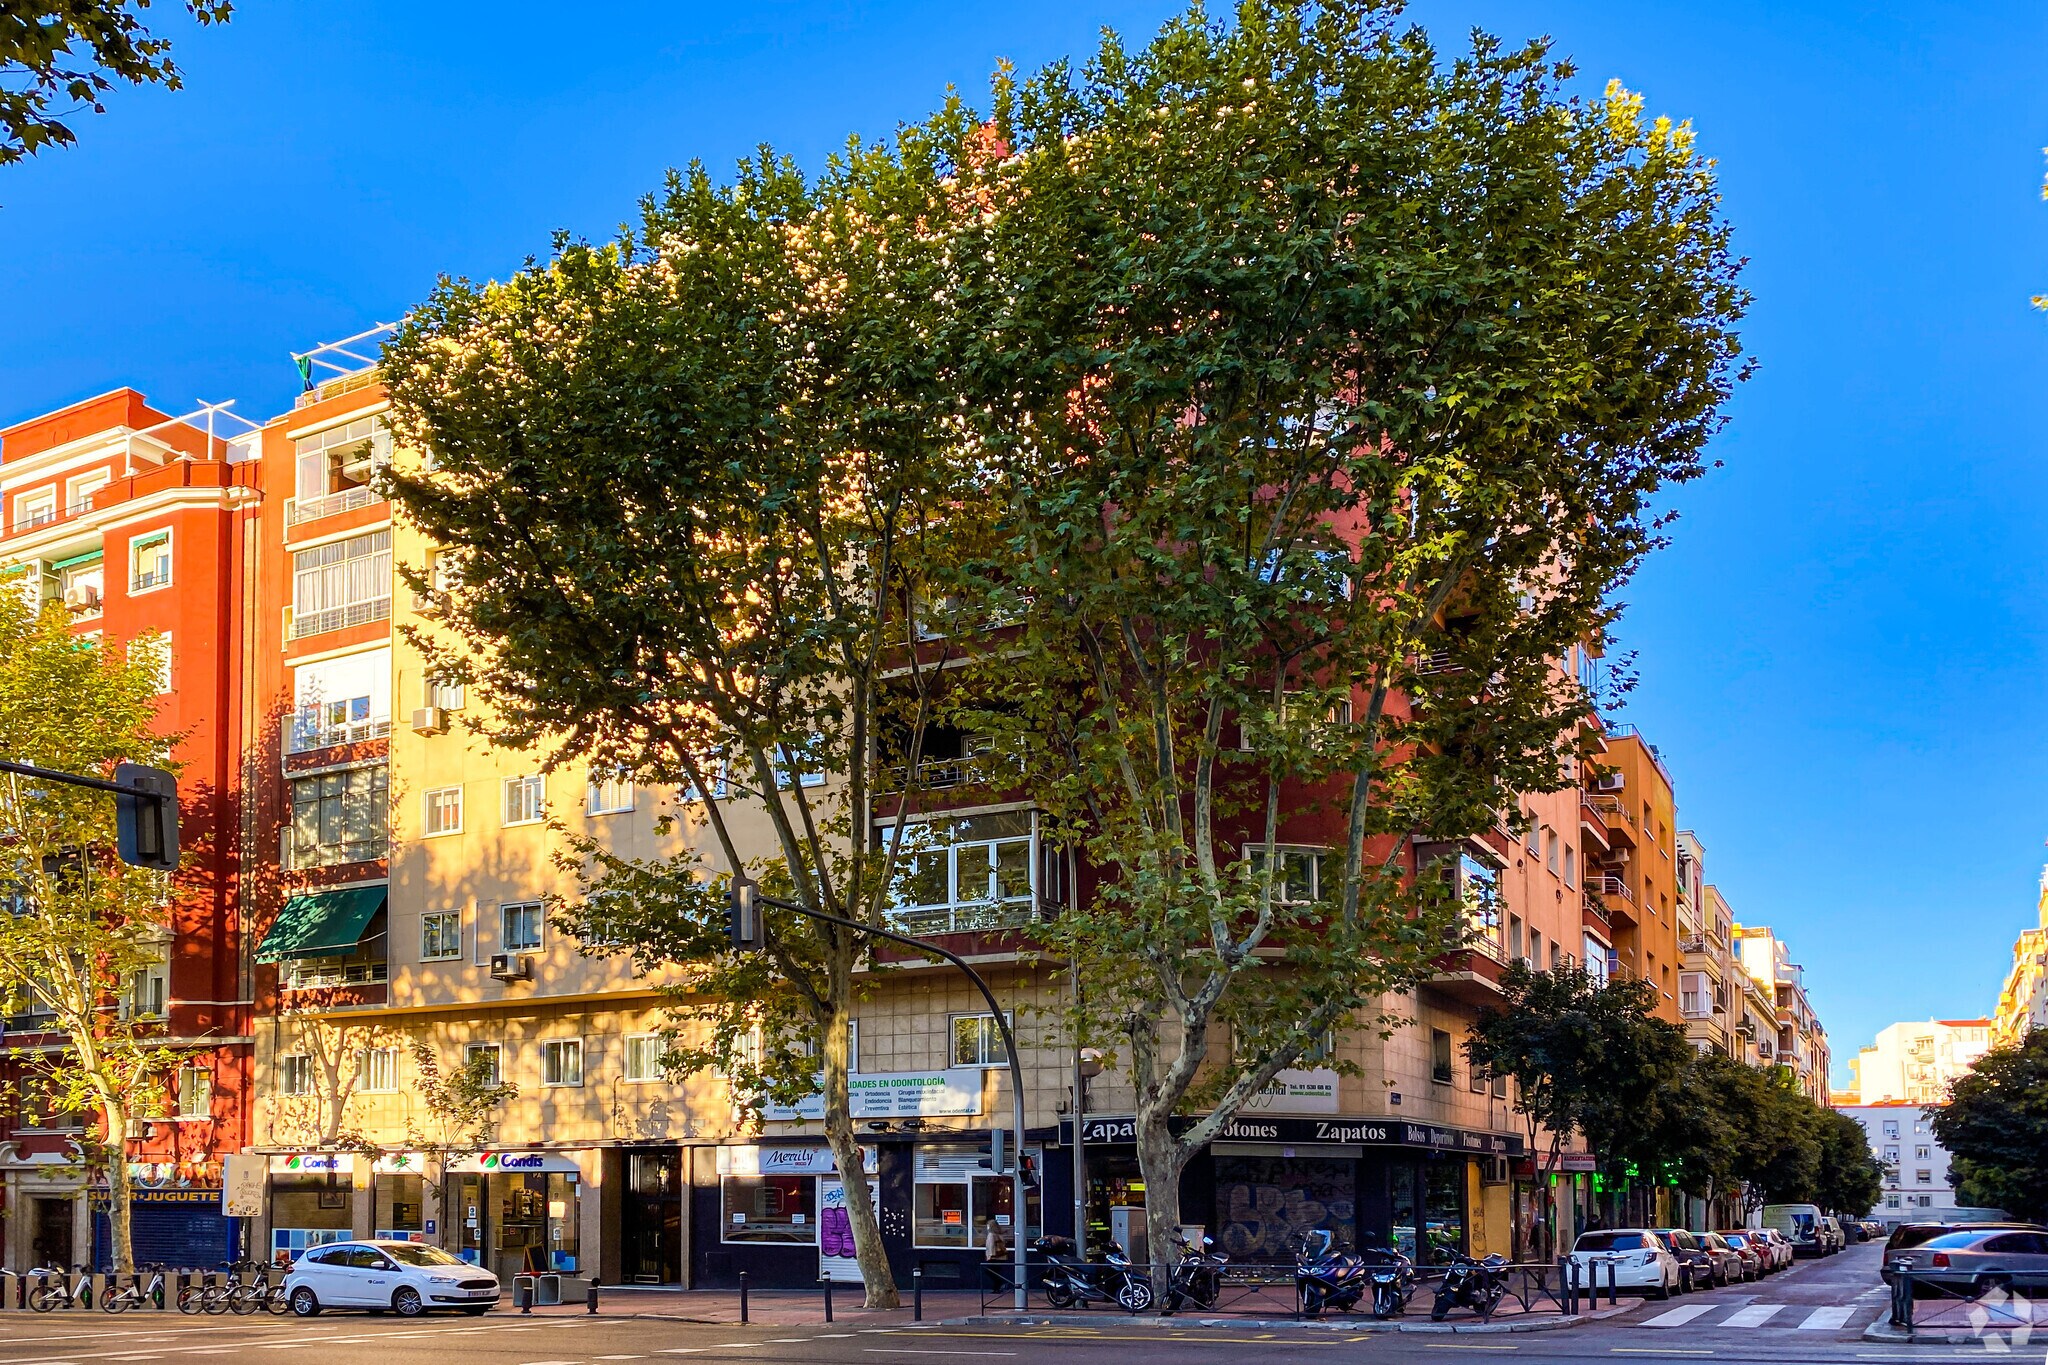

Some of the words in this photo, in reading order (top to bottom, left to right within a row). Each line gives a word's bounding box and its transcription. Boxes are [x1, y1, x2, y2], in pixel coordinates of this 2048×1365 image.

[879, 1080, 889, 1088] EN
[891, 1076, 946, 1087] ODONTOLOGÍA
[1316, 1122, 1387, 1143] Zapatos
[1407, 1125, 1426, 1143] Bolsos
[1491, 1136, 1507, 1154] Zapatos
[303, 1155, 340, 1168] Condis
[501, 1153, 544, 1168] Condis
[766, 1148, 814, 1166] Merrily
[142, 1192, 220, 1202] JUGUETE
